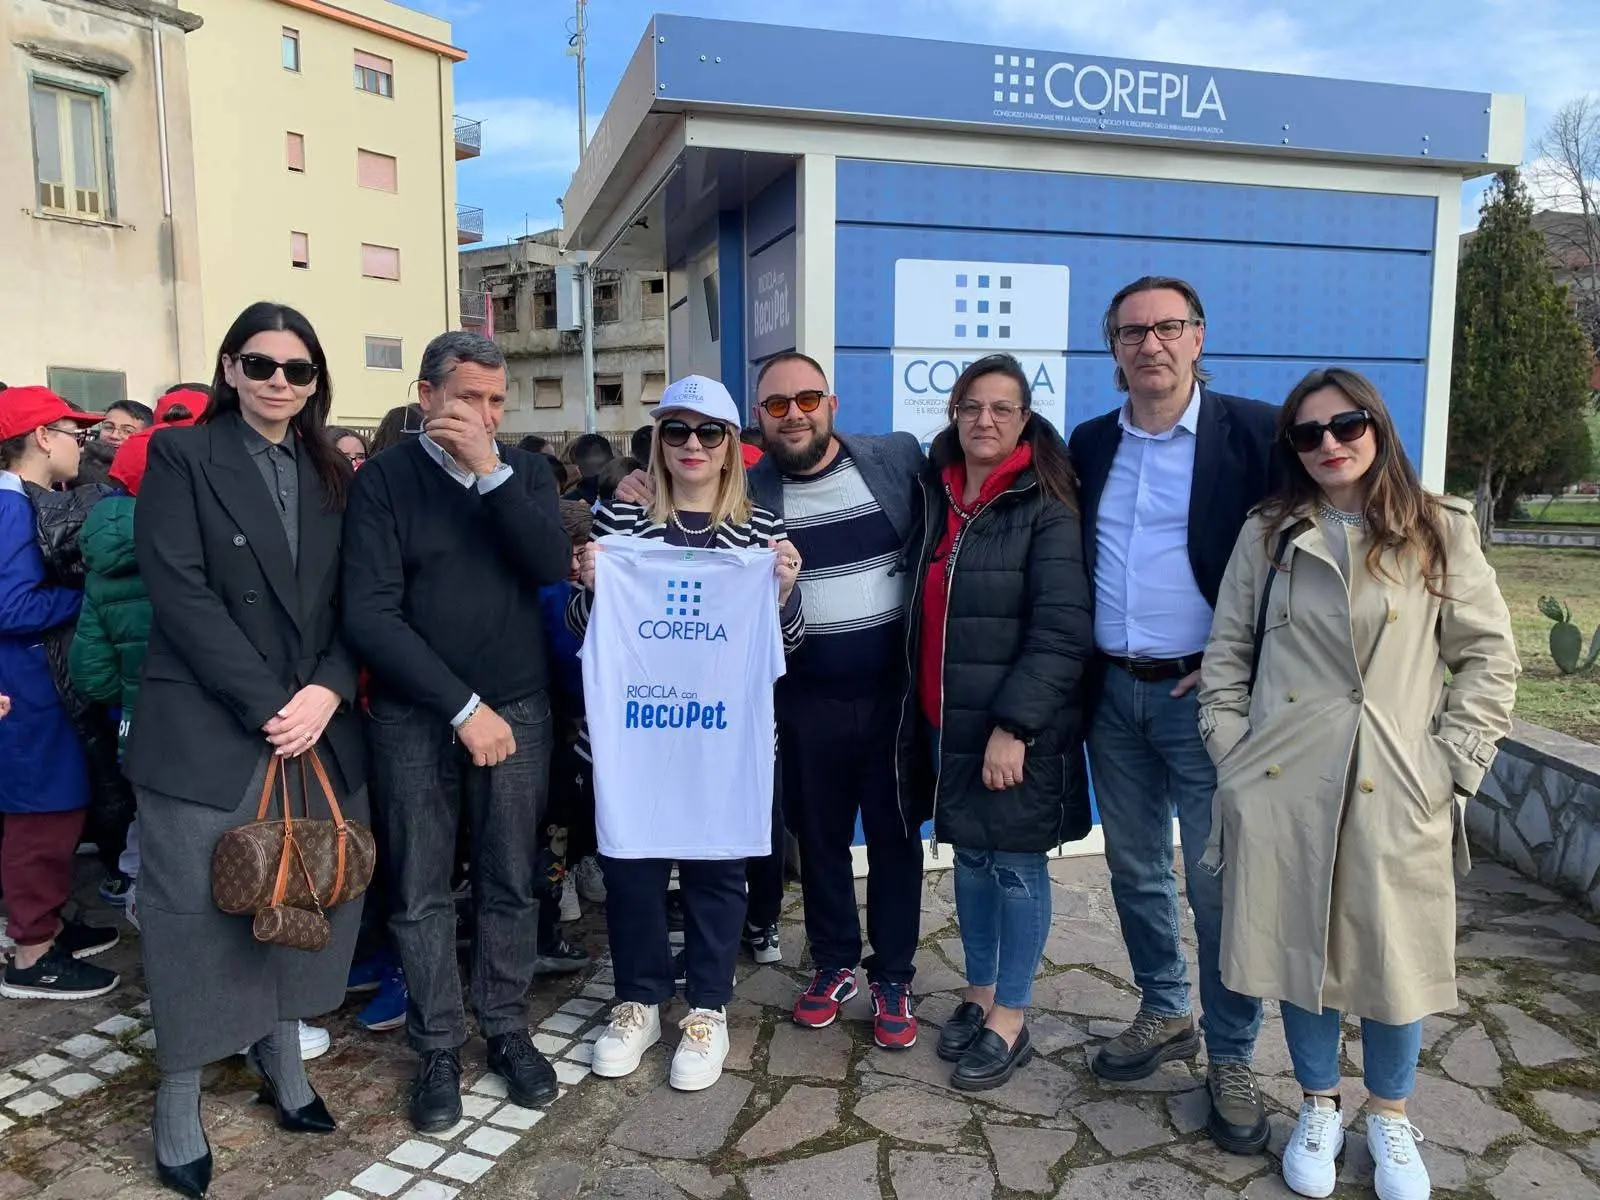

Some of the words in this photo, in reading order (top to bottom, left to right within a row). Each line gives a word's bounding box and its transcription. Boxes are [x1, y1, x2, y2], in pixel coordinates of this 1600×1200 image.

[1044, 62, 1227, 121] COREPLA
[638, 620, 728, 642] COREPLA
[626, 685, 678, 699] RICICLA
[681, 691, 698, 699] con
[625, 700, 728, 730] RecuPet
